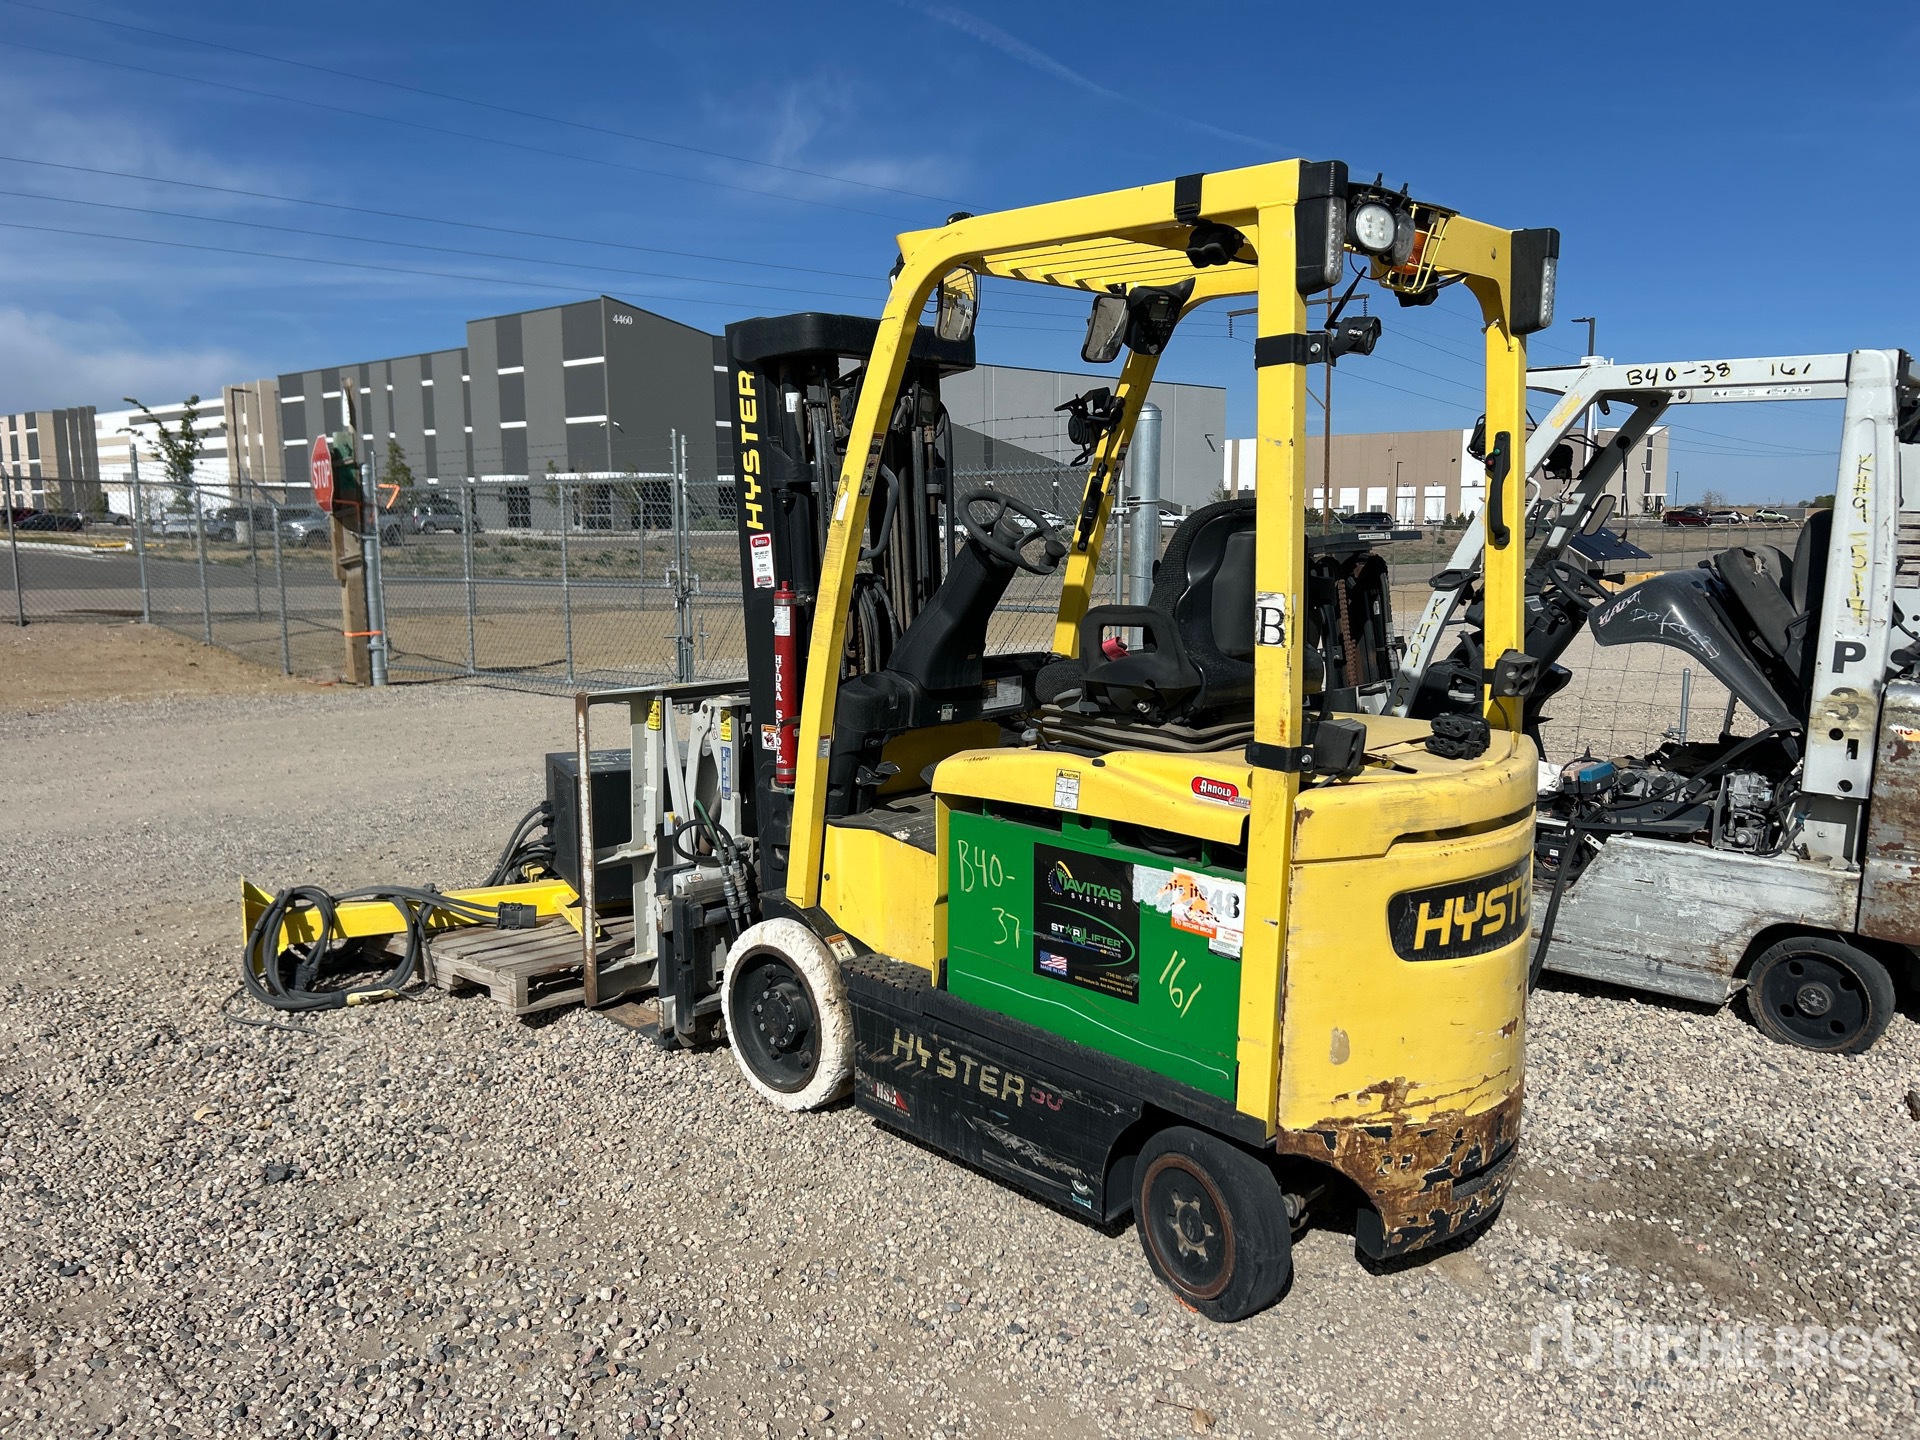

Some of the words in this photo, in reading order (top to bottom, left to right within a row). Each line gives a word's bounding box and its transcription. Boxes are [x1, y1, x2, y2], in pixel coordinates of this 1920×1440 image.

[612, 314, 633, 325] 4460
[1626, 362, 1731, 387] B40-38
[1770, 362, 1812, 377] 161
[738, 370, 764, 531] HYSTER
[312, 460, 331, 489] STOP
[1258, 606, 1286, 645] B
[774, 654, 783, 702] HYDRA
[1199, 779, 1232, 797] ARNOLD
[958, 839, 1015, 893] B40-
[1070, 892, 1122, 911] SYSTEMS
[991, 907, 1020, 949] 37
[1040, 963, 1052, 972] MADE
[1159, 949, 1203, 1018] 161
[891, 1027, 1025, 1108] HYSTER
